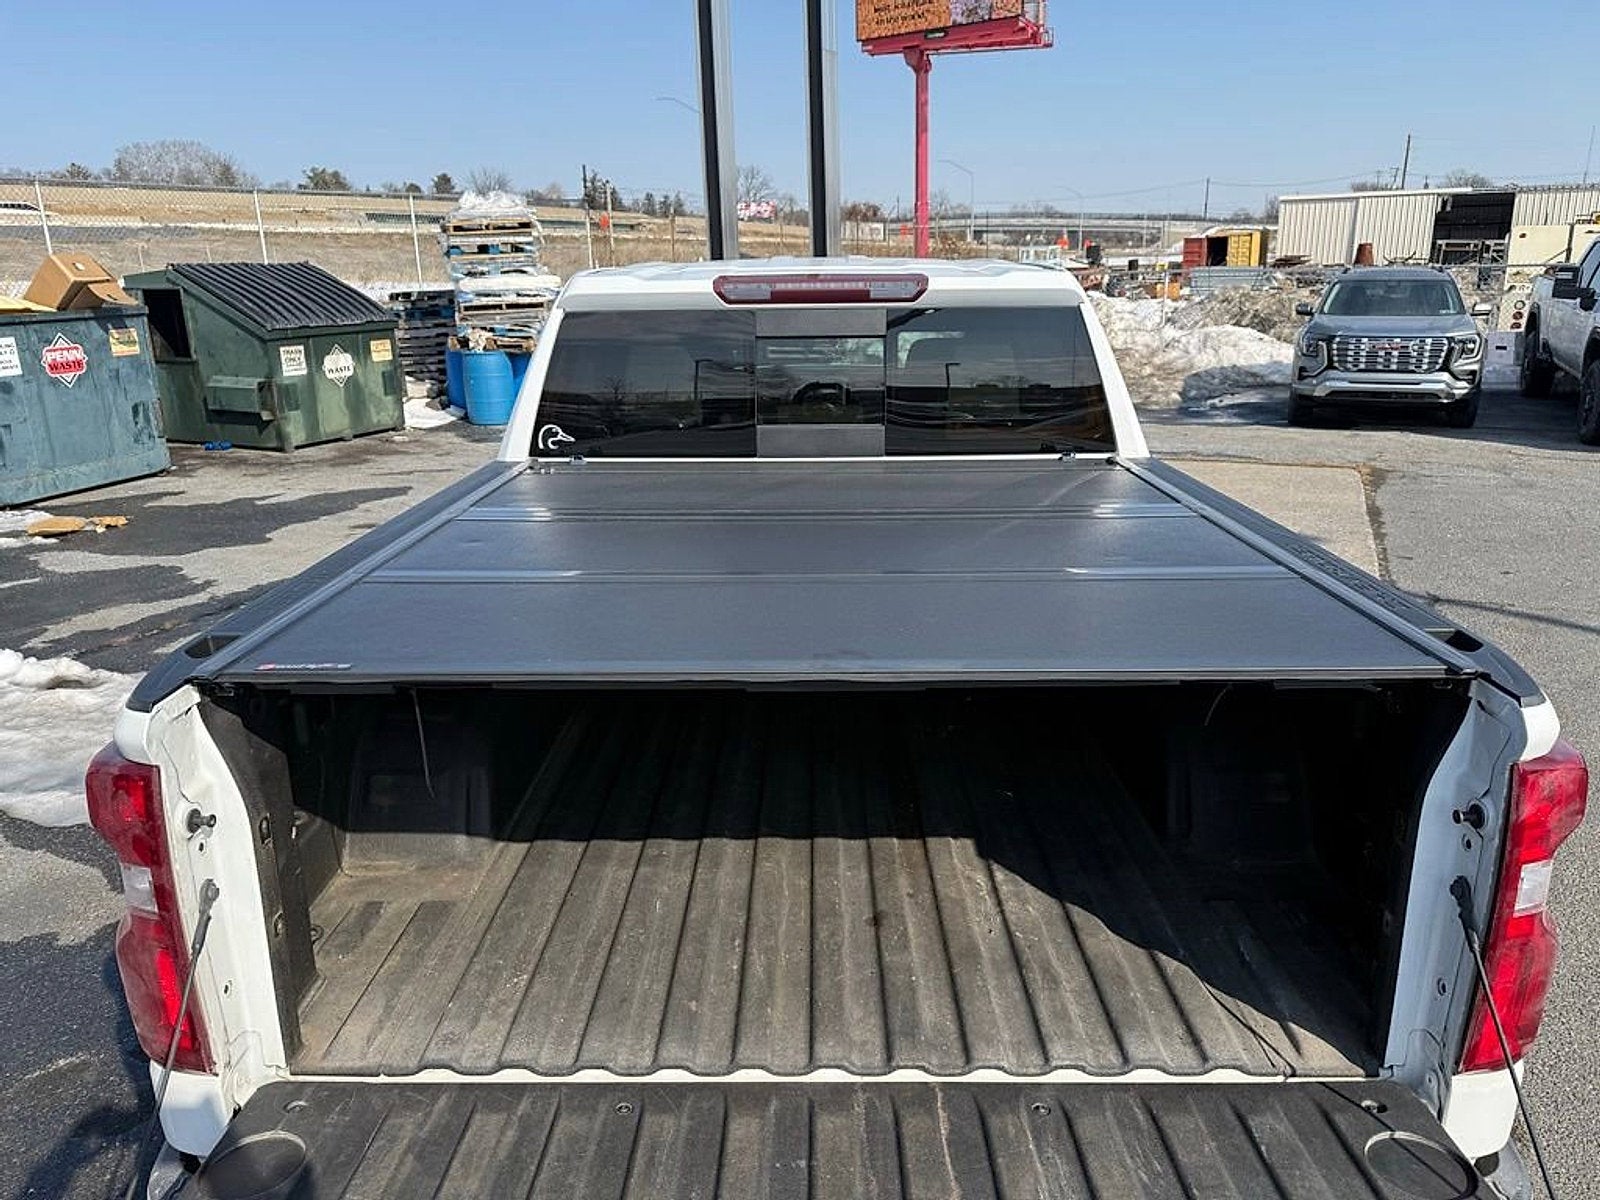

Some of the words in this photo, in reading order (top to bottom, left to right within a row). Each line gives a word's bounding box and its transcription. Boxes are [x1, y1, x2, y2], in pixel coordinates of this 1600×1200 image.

[46, 349, 82, 363] PENN
[48, 360, 83, 371] WASTE
[326, 366, 350, 374] WASTE
